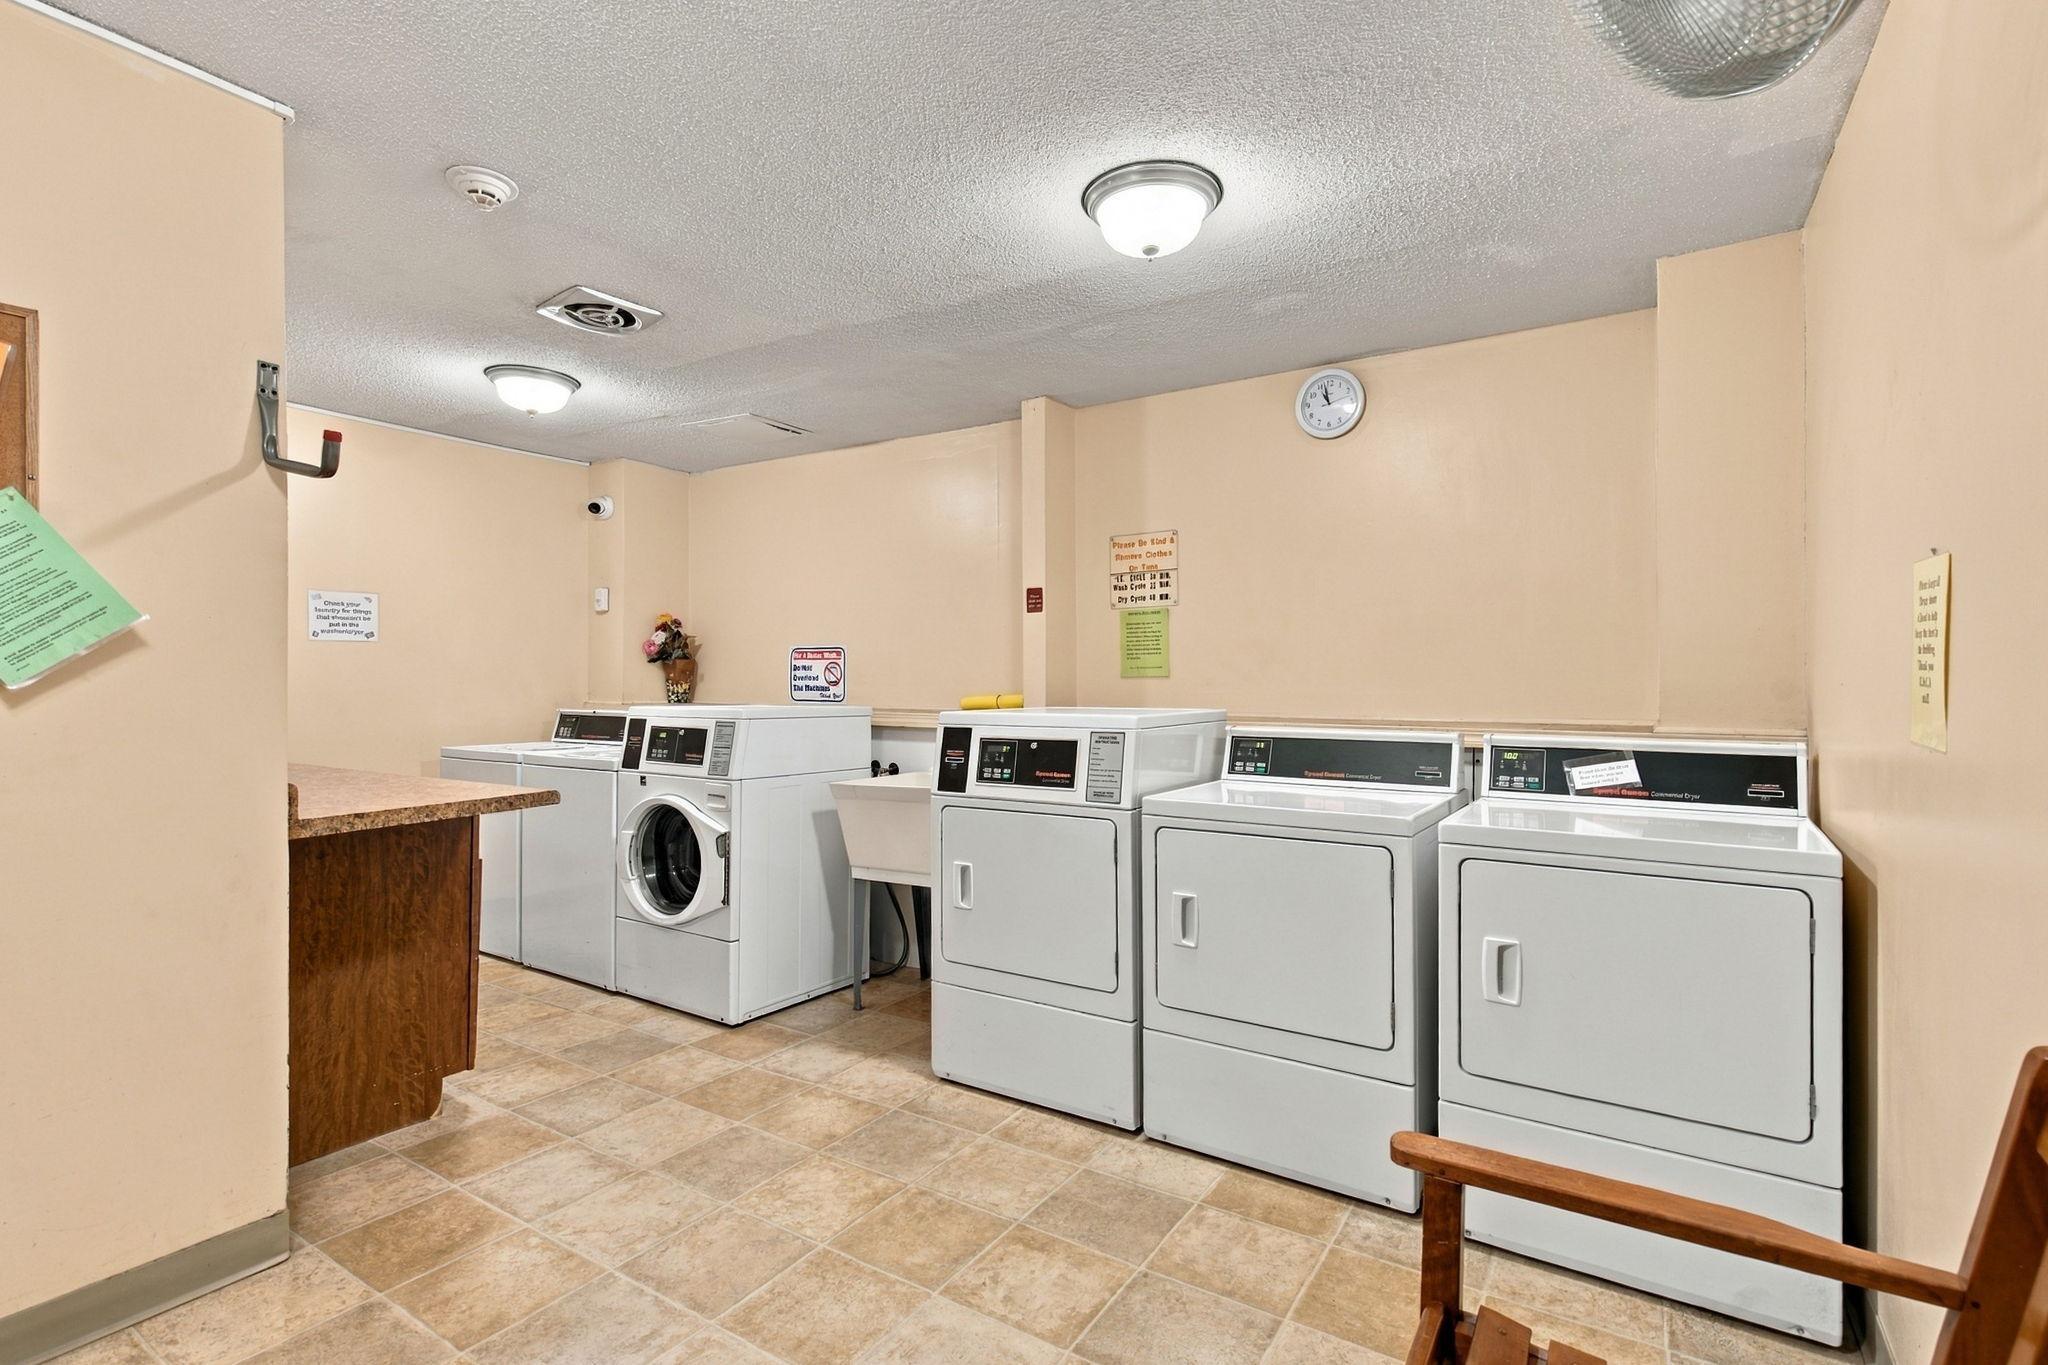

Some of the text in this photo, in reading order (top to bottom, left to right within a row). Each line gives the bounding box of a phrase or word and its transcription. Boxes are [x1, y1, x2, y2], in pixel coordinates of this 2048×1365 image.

[1113, 541, 1135, 549] Please
[1138, 539, 1147, 547] Be
[1151, 537, 1166, 545] Kind
[1146, 550, 1172, 558] Clothes
[1130, 583, 1146, 591] Cycle
[1118, 596, 1128, 604] Dry
[1130, 595, 1146, 603] Cycle
[805, 684, 830, 692] Machines
[1621, 789, 1649, 797] Queen
[1651, 791, 1683, 799] Commercial
[1684, 792, 1701, 800] Dryer
